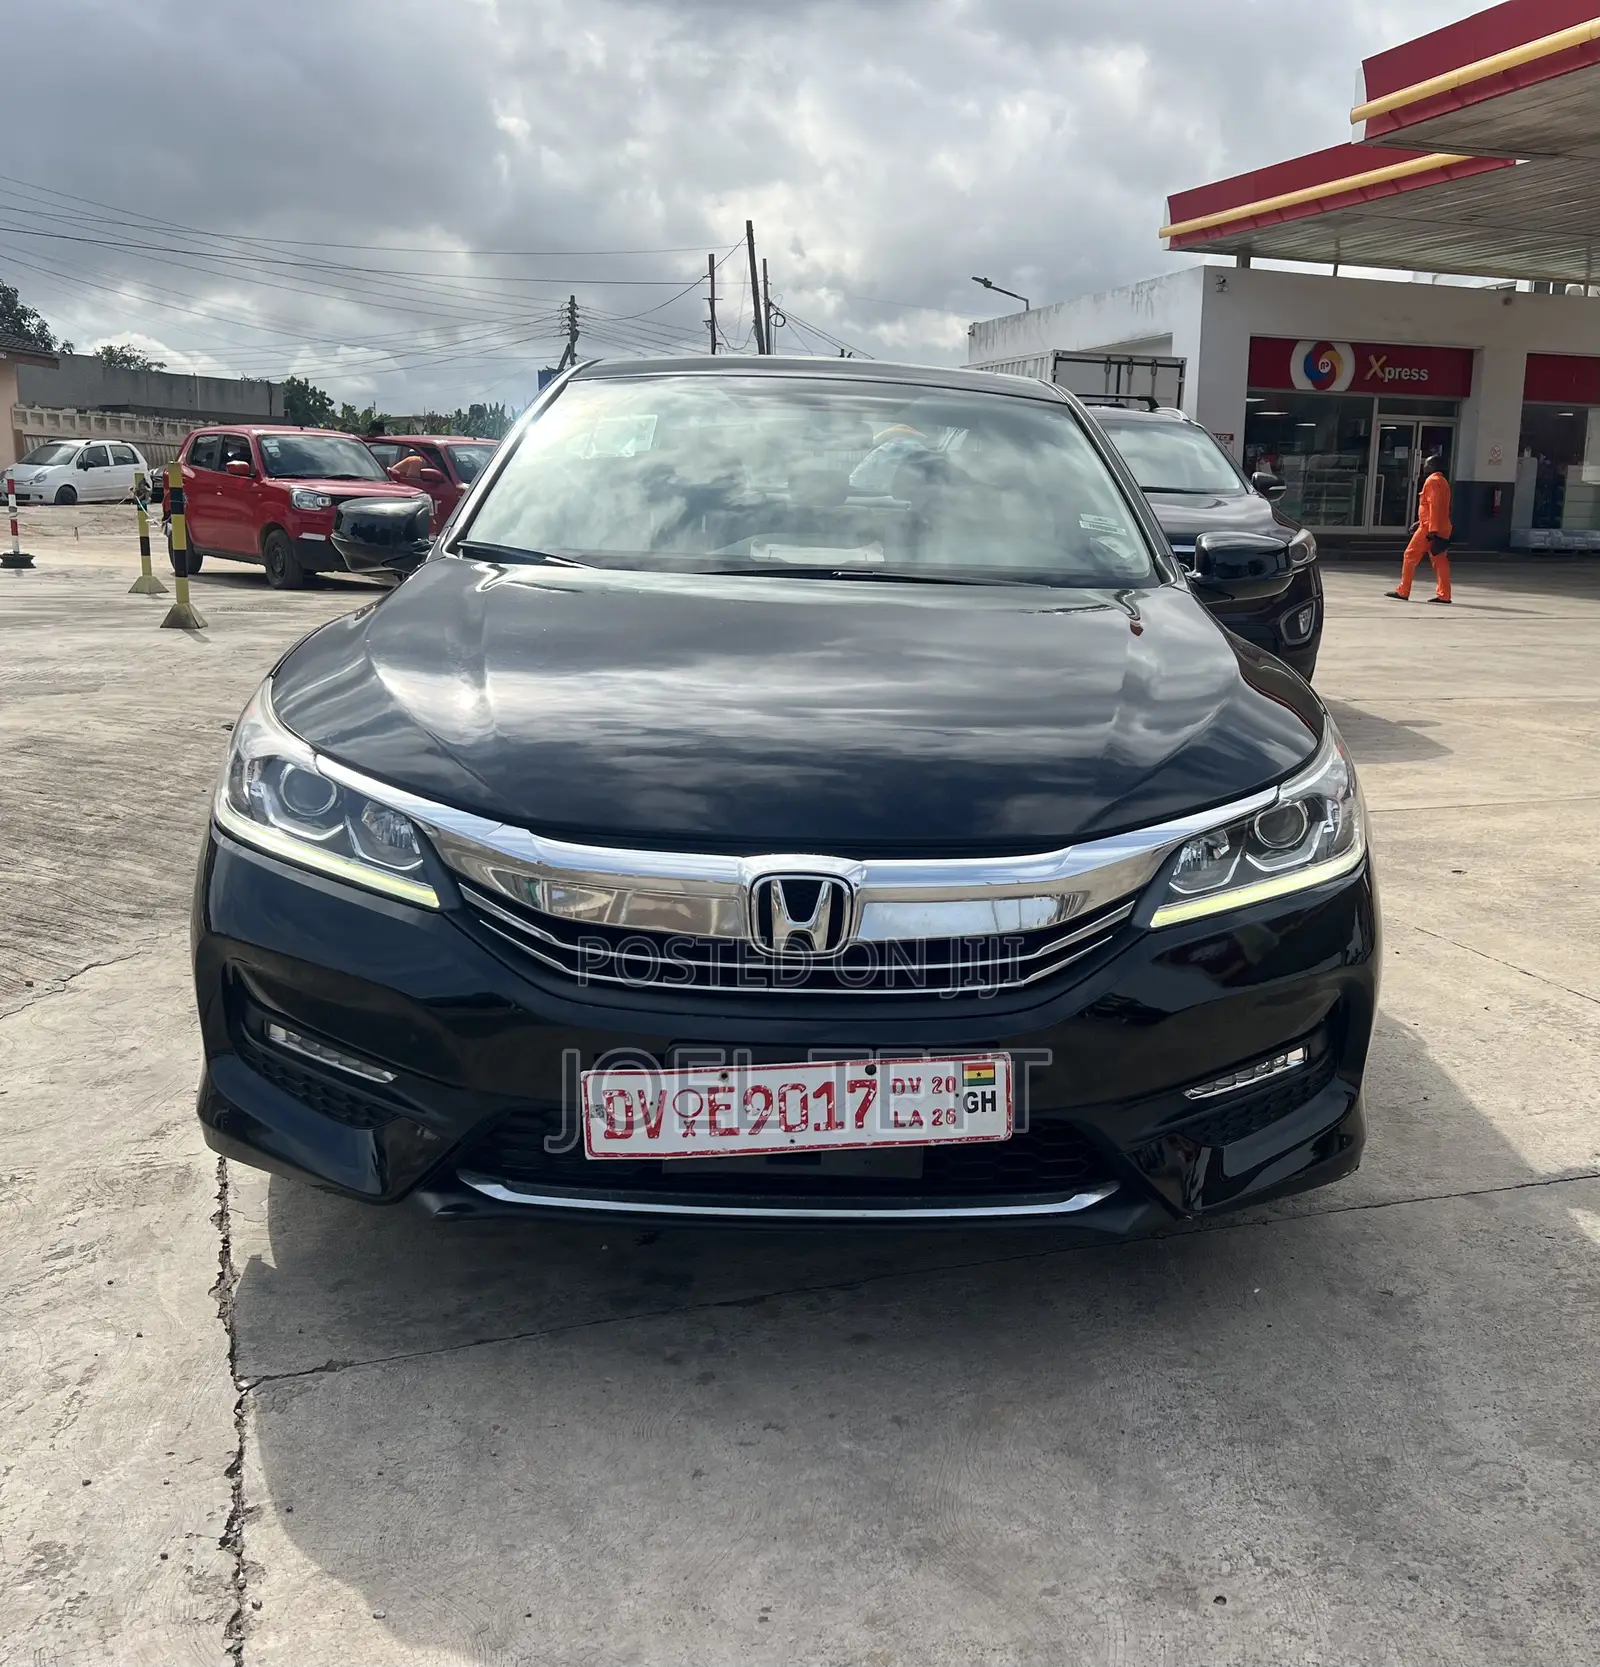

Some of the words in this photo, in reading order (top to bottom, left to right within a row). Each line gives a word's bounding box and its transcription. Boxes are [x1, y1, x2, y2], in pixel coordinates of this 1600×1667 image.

[1364, 354, 1429, 383] Xpress
[891, 1076, 922, 1095] DV
[931, 1075, 957, 1094] 20
[707, 1078, 878, 1137] E9017
[962, 1090, 997, 1114] GH
[893, 1109, 924, 1128] LA
[931, 1108, 957, 1127] 26
